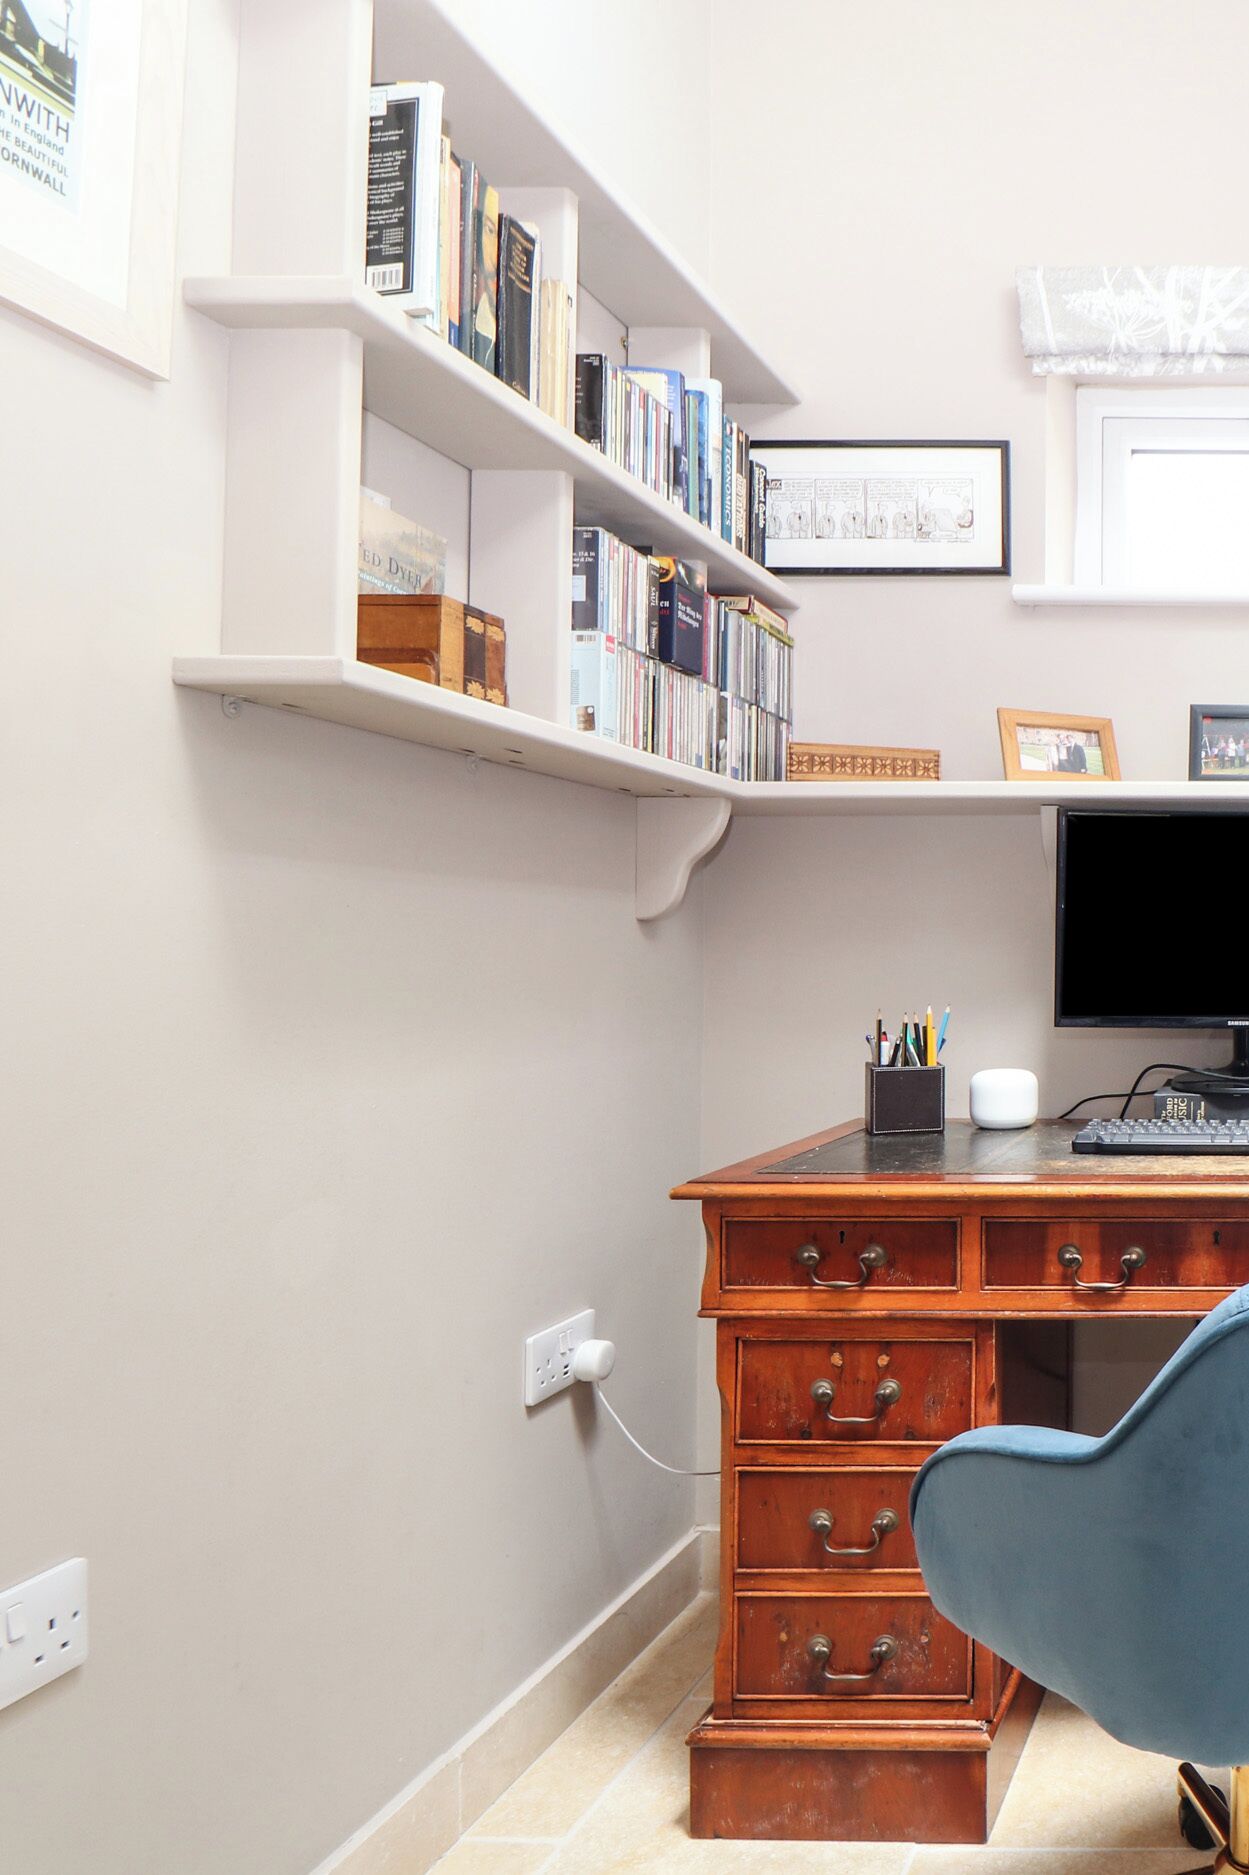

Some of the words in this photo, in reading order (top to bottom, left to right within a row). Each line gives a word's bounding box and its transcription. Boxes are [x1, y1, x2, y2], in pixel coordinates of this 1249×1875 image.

[24, 122, 64, 156] England
[1, 146, 66, 196] ORNWALL
[15, 136, 68, 178] BEAUTIFUL
[758, 468, 766, 502] Concert
[758, 503, 767, 528] Guide
[360, 545, 381, 567] ED
